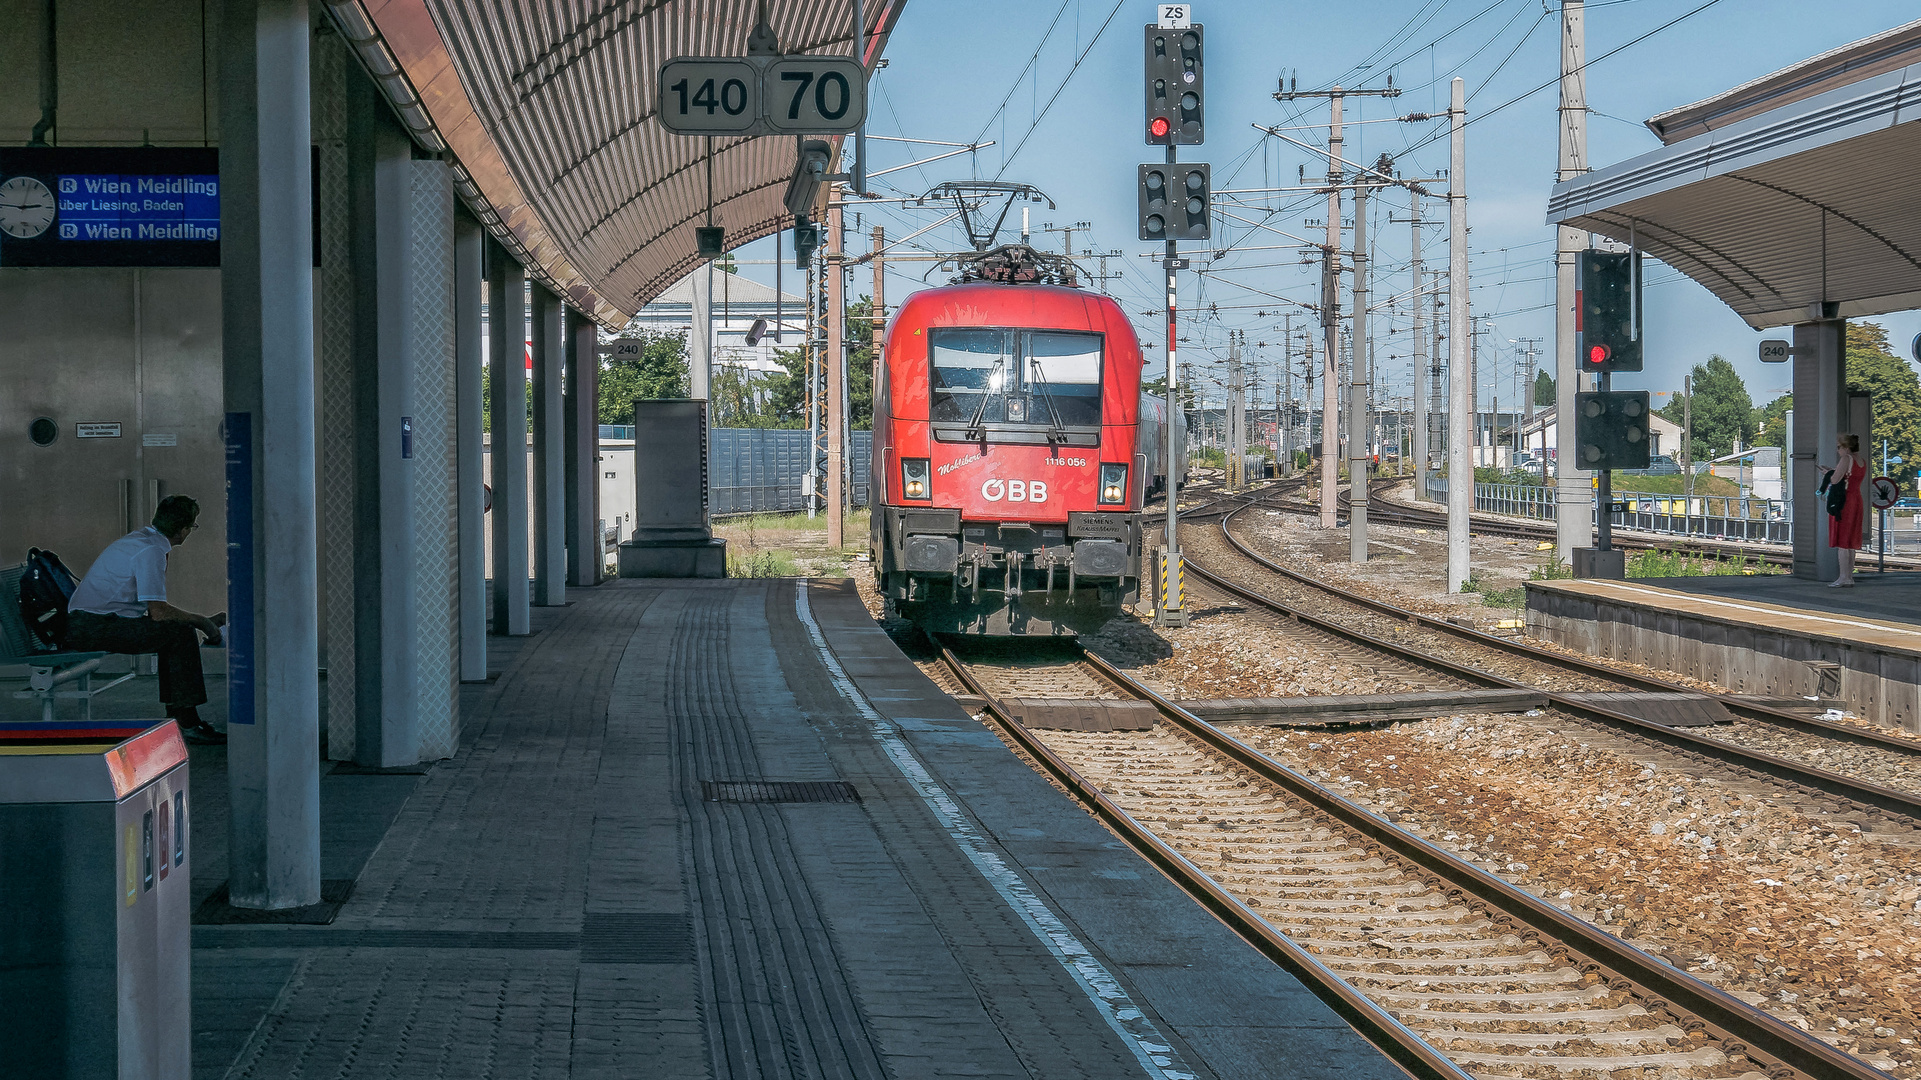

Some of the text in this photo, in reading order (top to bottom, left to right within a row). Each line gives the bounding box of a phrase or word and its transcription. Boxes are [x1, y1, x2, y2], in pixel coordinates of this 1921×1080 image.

[1164, 7, 1184, 19] ZS
[670, 78, 748, 116] 140
[780, 70, 851, 121] 70
[84, 178, 132, 194] Wien
[137, 178, 217, 197] Meidling
[59, 199, 184, 214] über Liesing, Baden
[85, 223, 132, 239] Wien
[138, 223, 218, 241] Meidling
[617, 344, 639, 355] 240
[1763, 346, 1786, 357] 240
[1044, 457, 1087, 467] 1116 056
[981, 478, 1048, 503] ÖBB
